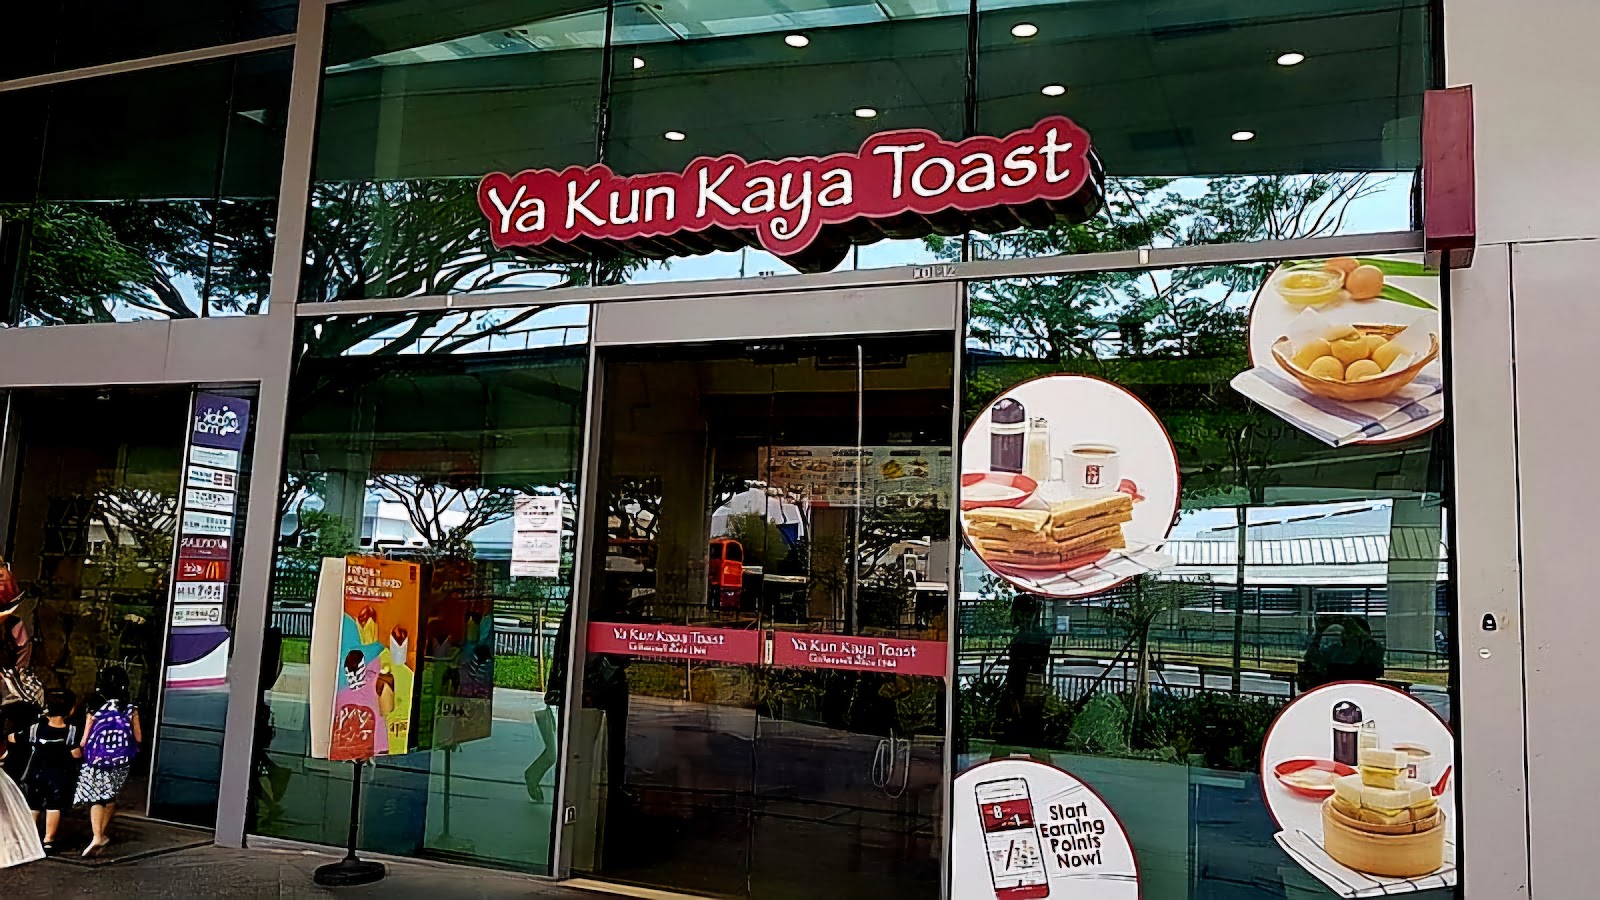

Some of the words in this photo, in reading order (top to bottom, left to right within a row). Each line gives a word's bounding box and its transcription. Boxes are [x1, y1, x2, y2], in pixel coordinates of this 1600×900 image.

[487, 184, 546, 235] Ya
[565, 178, 676, 230] Kun
[695, 164, 853, 241] Kaya
[872, 127, 1073, 199] Toast
[809, 639, 837, 653] Kun
[878, 642, 917, 658] Toast
[1050, 802, 1088, 820] Start
[1040, 819, 1105, 838] Earning
[1051, 835, 1101, 853] Points
[1057, 851, 1102, 868] Now!
